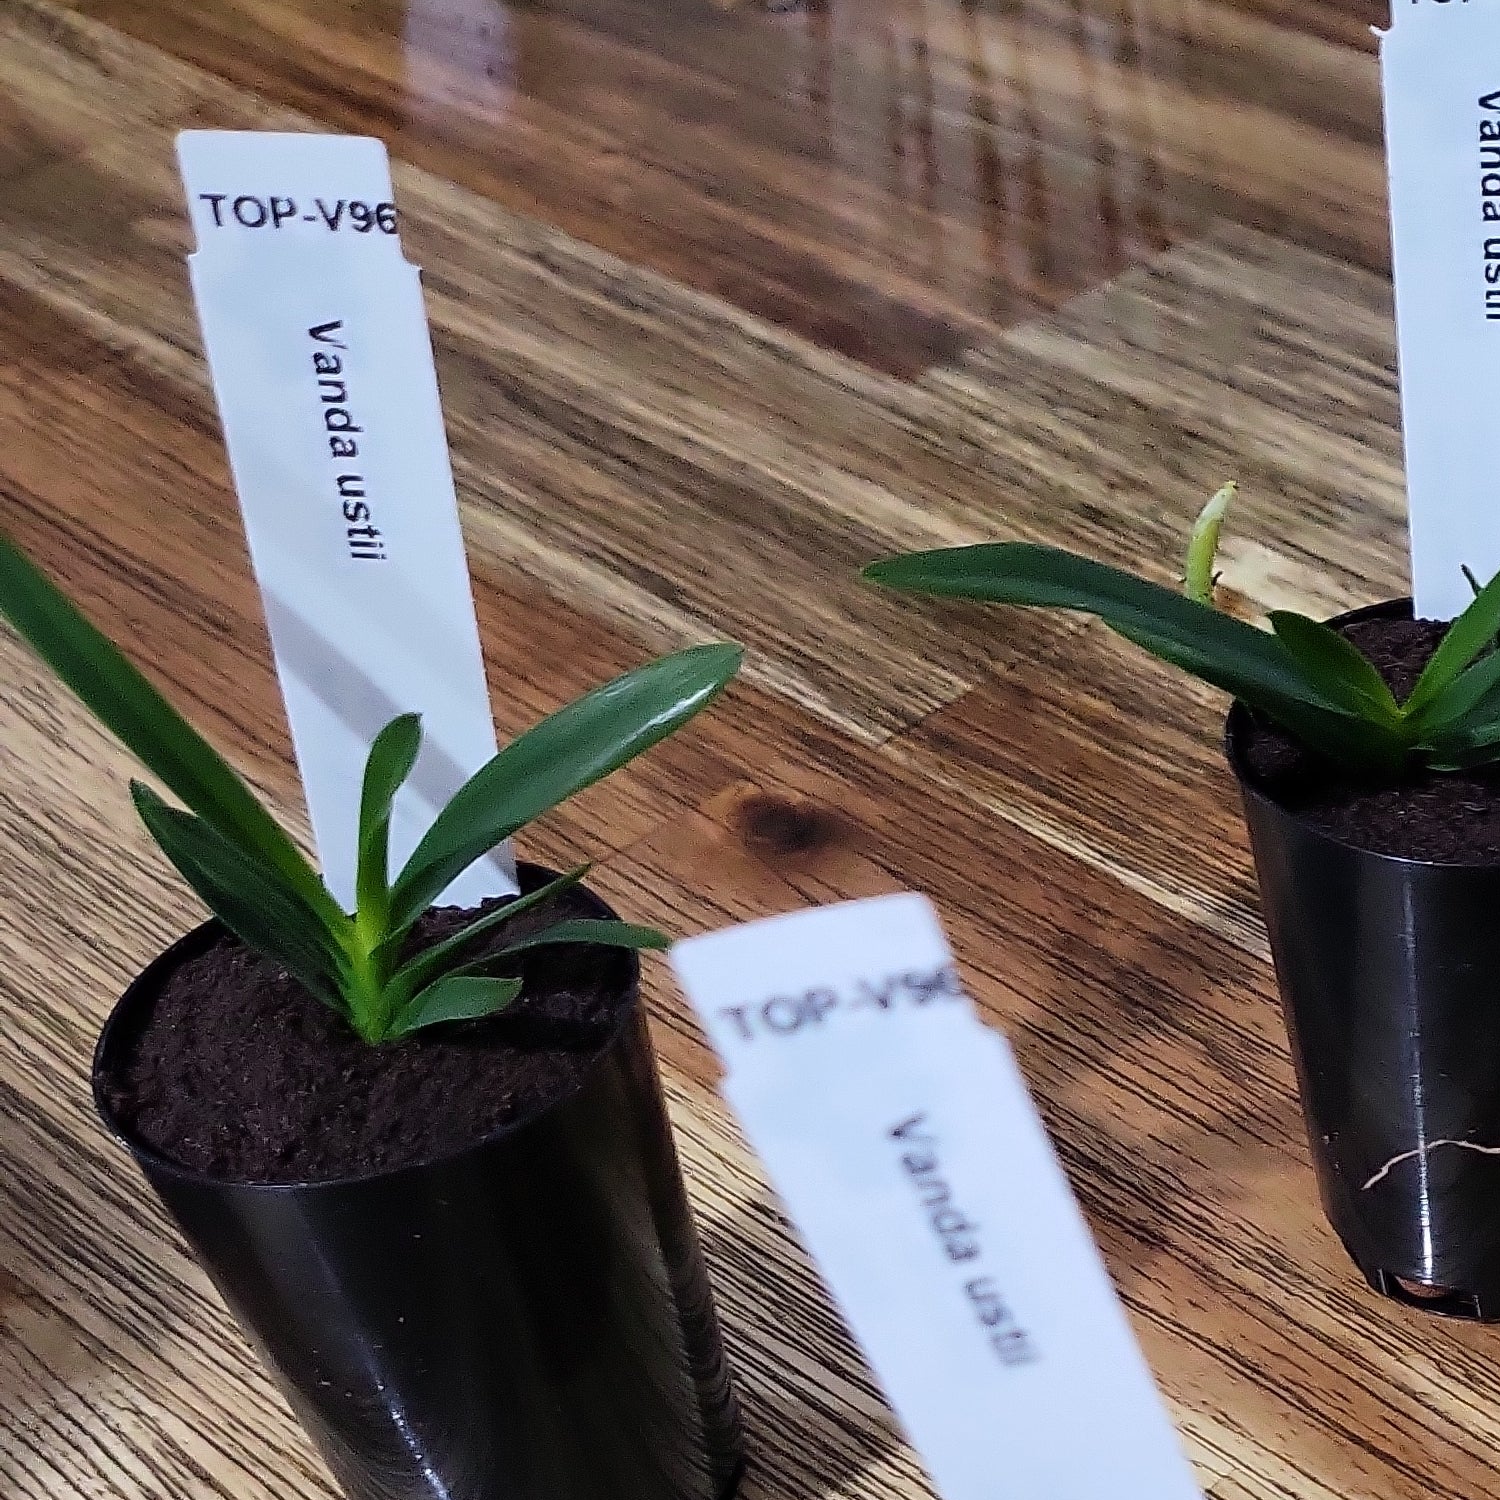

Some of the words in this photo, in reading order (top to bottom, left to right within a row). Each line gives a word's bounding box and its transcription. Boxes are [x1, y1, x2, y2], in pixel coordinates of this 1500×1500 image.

[199, 193, 399, 235] TOP-V96
[308, 319, 364, 459] Vanda
[336, 473, 388, 562] ustii
[886, 1111, 981, 1264] Vanda
